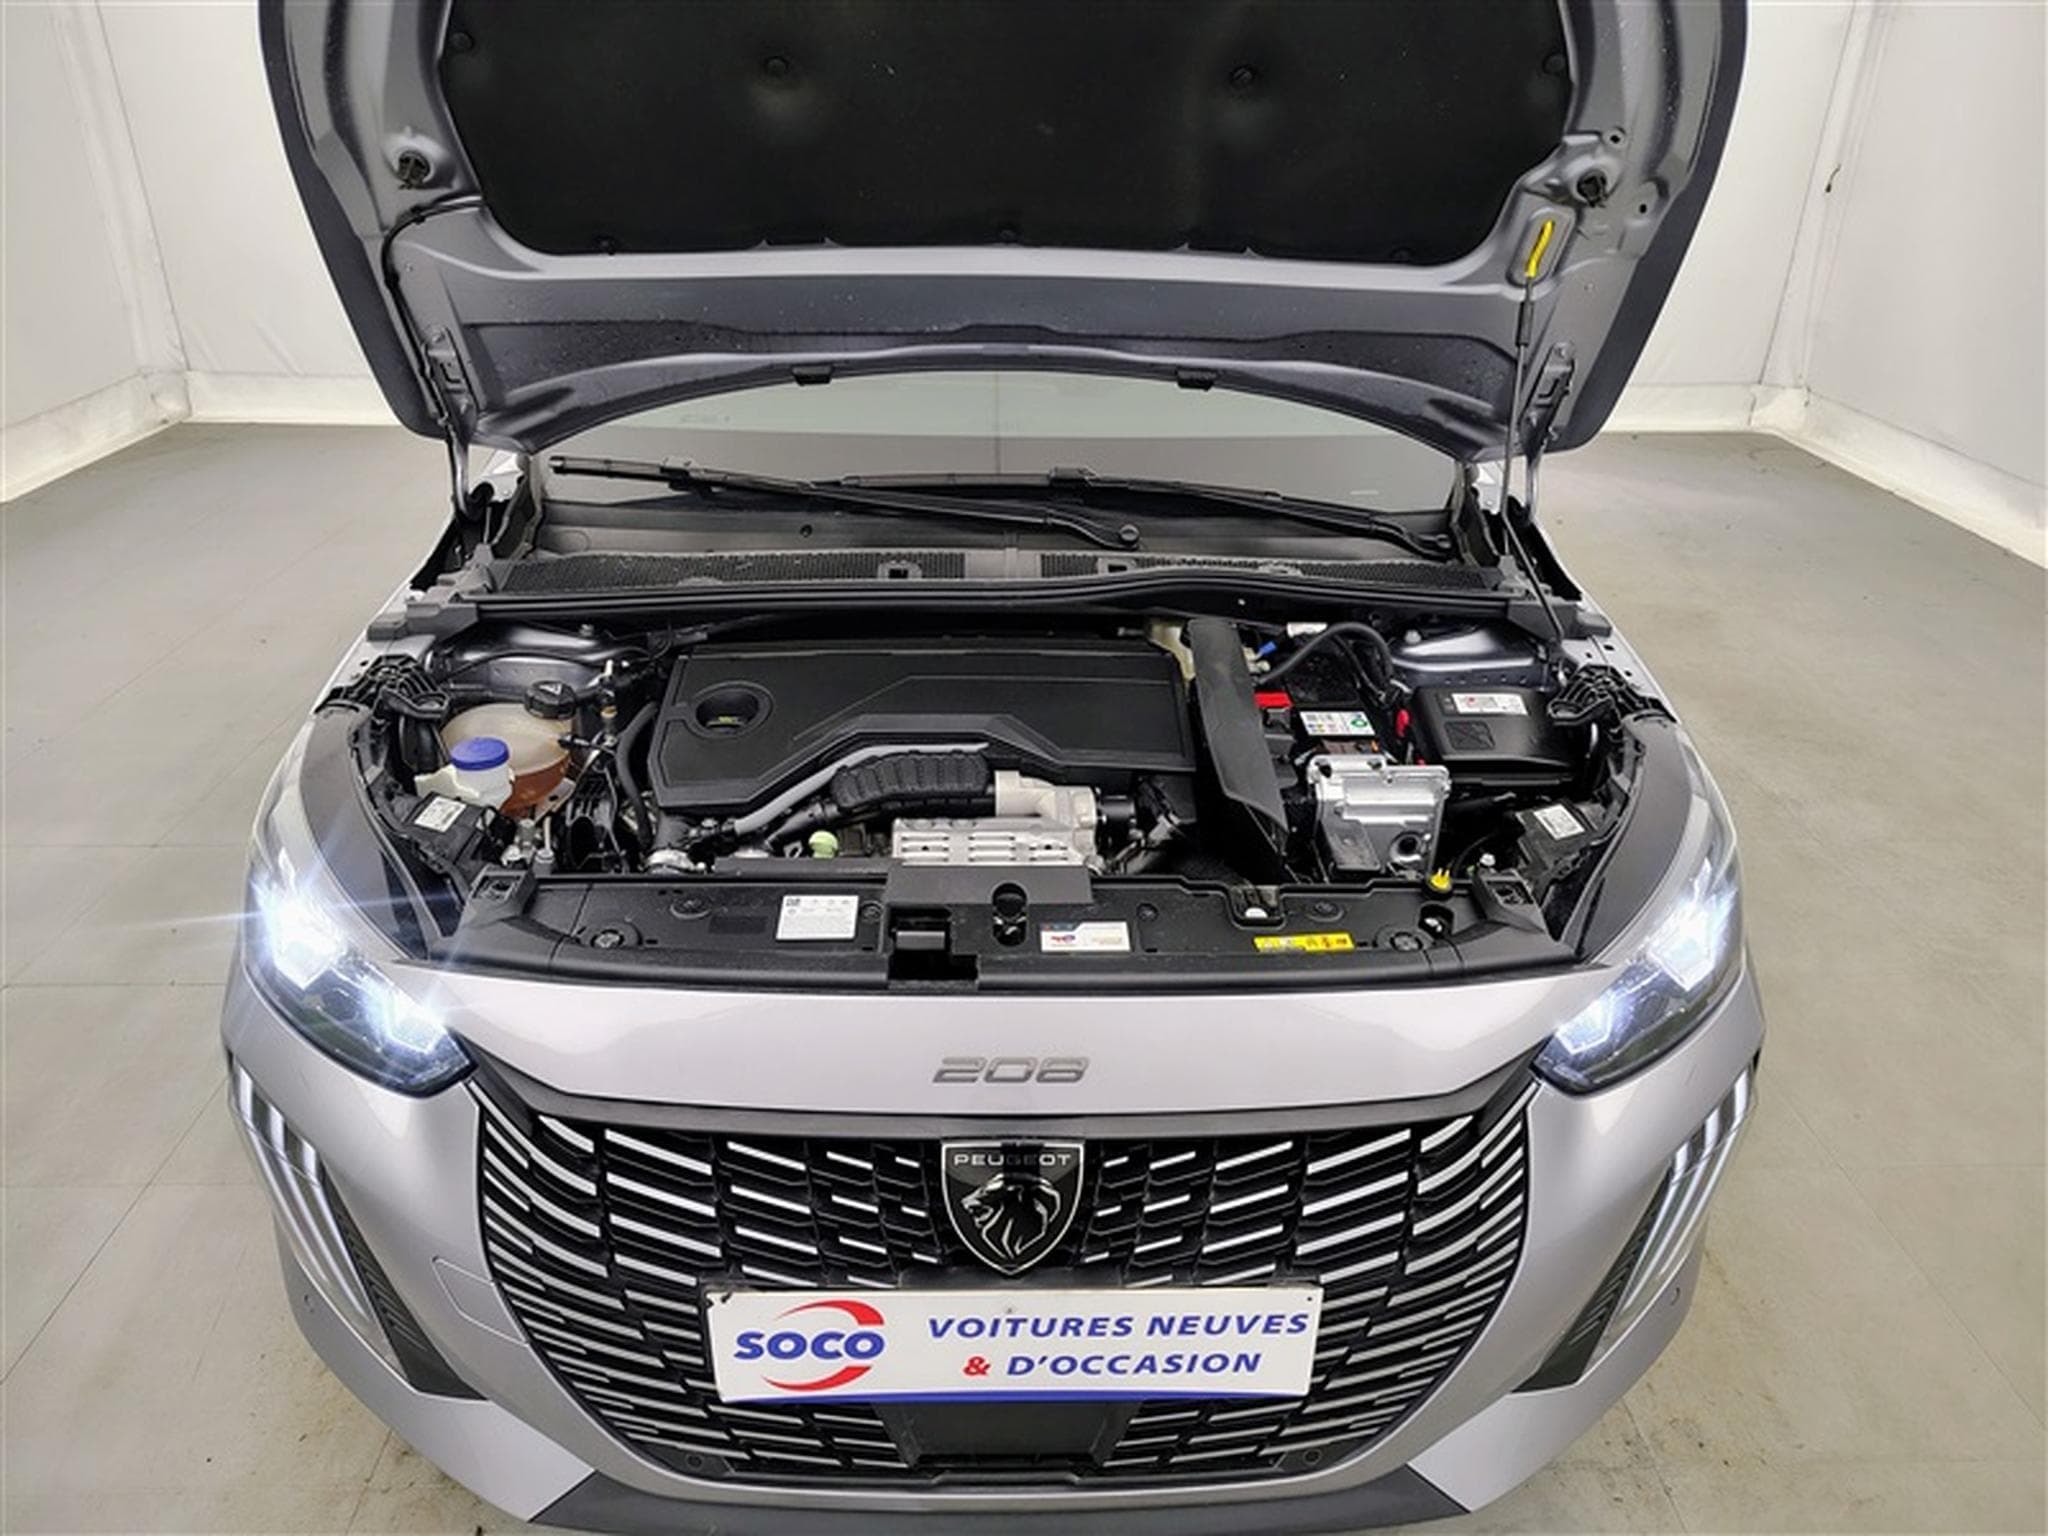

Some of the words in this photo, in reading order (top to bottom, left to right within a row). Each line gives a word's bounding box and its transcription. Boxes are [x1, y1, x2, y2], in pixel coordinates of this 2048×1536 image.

[933, 1057, 1089, 1084] 208
[953, 1153, 1071, 1167] PEUGEOT
[929, 1316, 1134, 1339] VOITURES
[1146, 1313, 1308, 1337] NEUVES
[735, 1331, 885, 1360] SOCO
[963, 1356, 990, 1376] &
[1007, 1353, 1261, 1377] D'OCCASION
